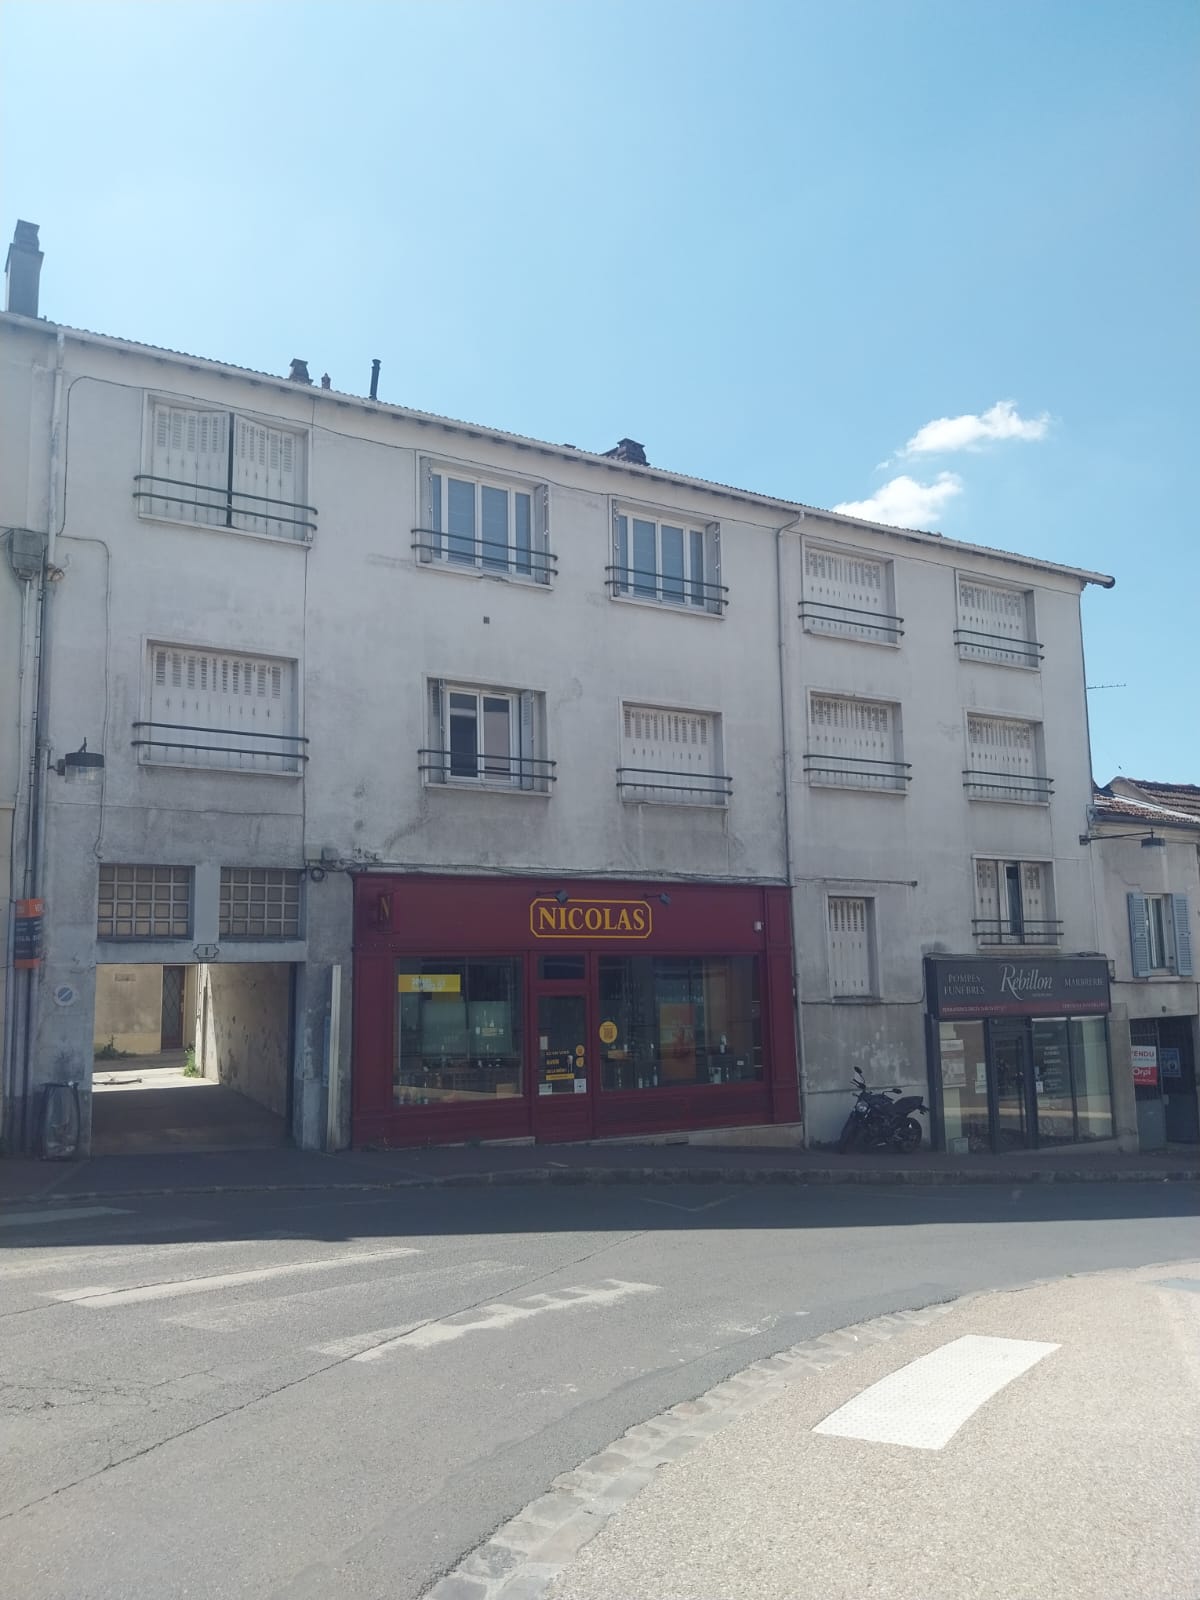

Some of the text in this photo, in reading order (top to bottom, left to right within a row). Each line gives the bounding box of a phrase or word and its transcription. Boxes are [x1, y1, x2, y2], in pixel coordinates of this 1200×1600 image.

[380, 895, 392, 921] N
[538, 907, 645, 932] NICOLAS
[948, 974, 984, 983] POMPES
[1000, 964, 1053, 1000] Rebillon
[1132, 1067, 1151, 1077] Orpi
